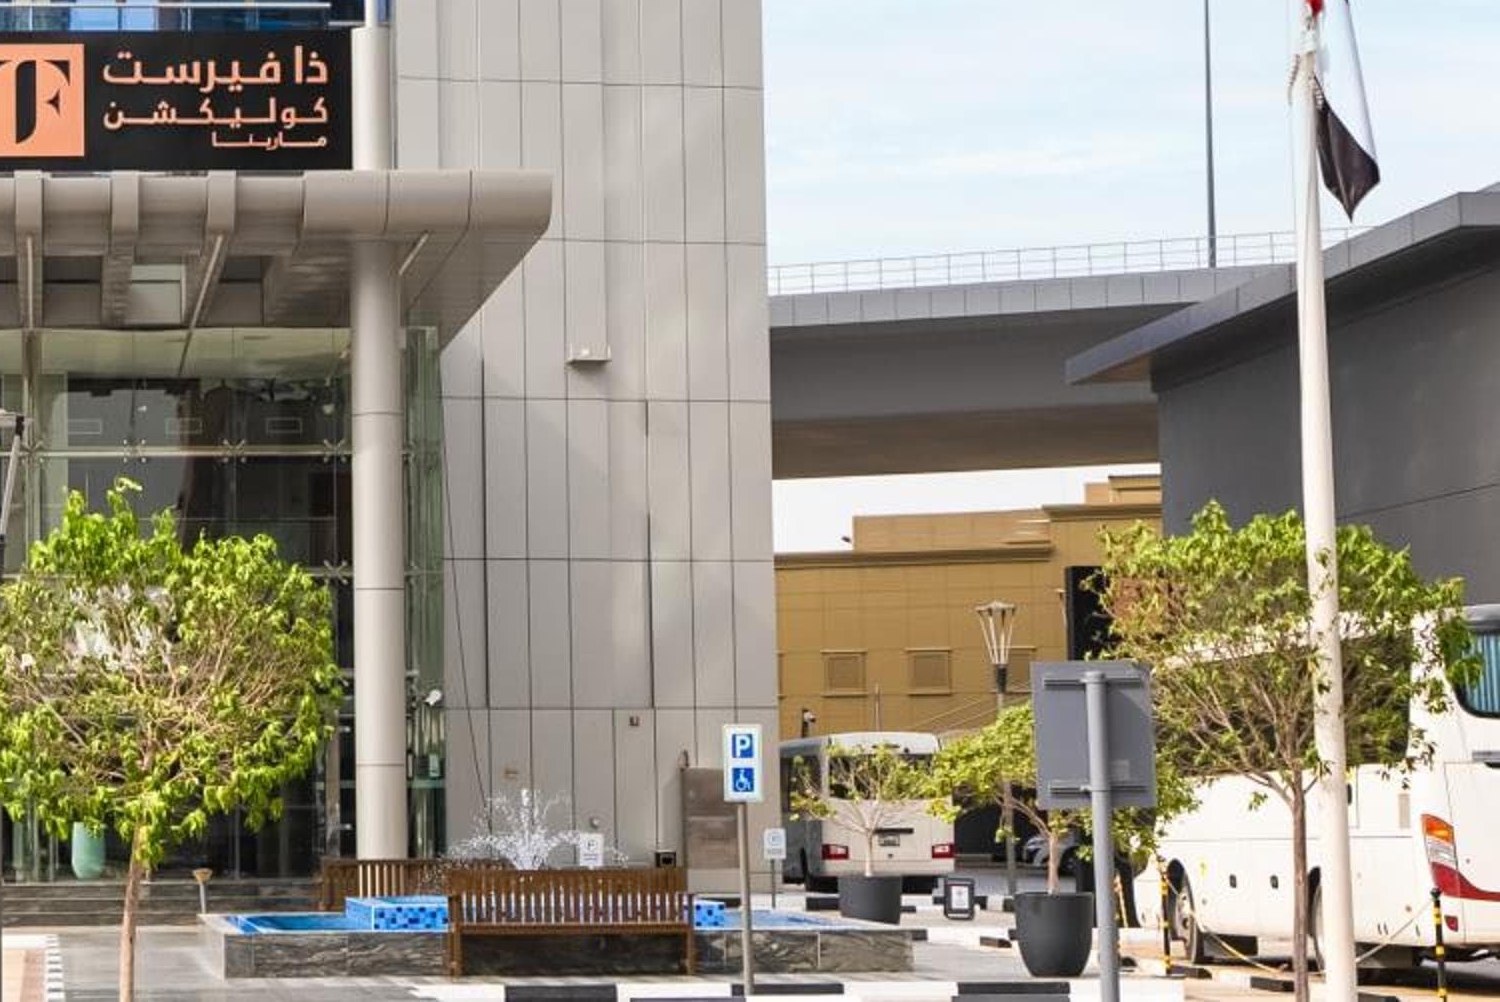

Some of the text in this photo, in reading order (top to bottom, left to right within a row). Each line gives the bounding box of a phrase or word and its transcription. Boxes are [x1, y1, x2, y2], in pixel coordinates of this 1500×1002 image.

[102, 45, 329, 93] ذا فيرست
[103, 97, 328, 130] كوليكشن
[211, 130, 328, 151] مارينا
[735, 734, 751, 758] P
